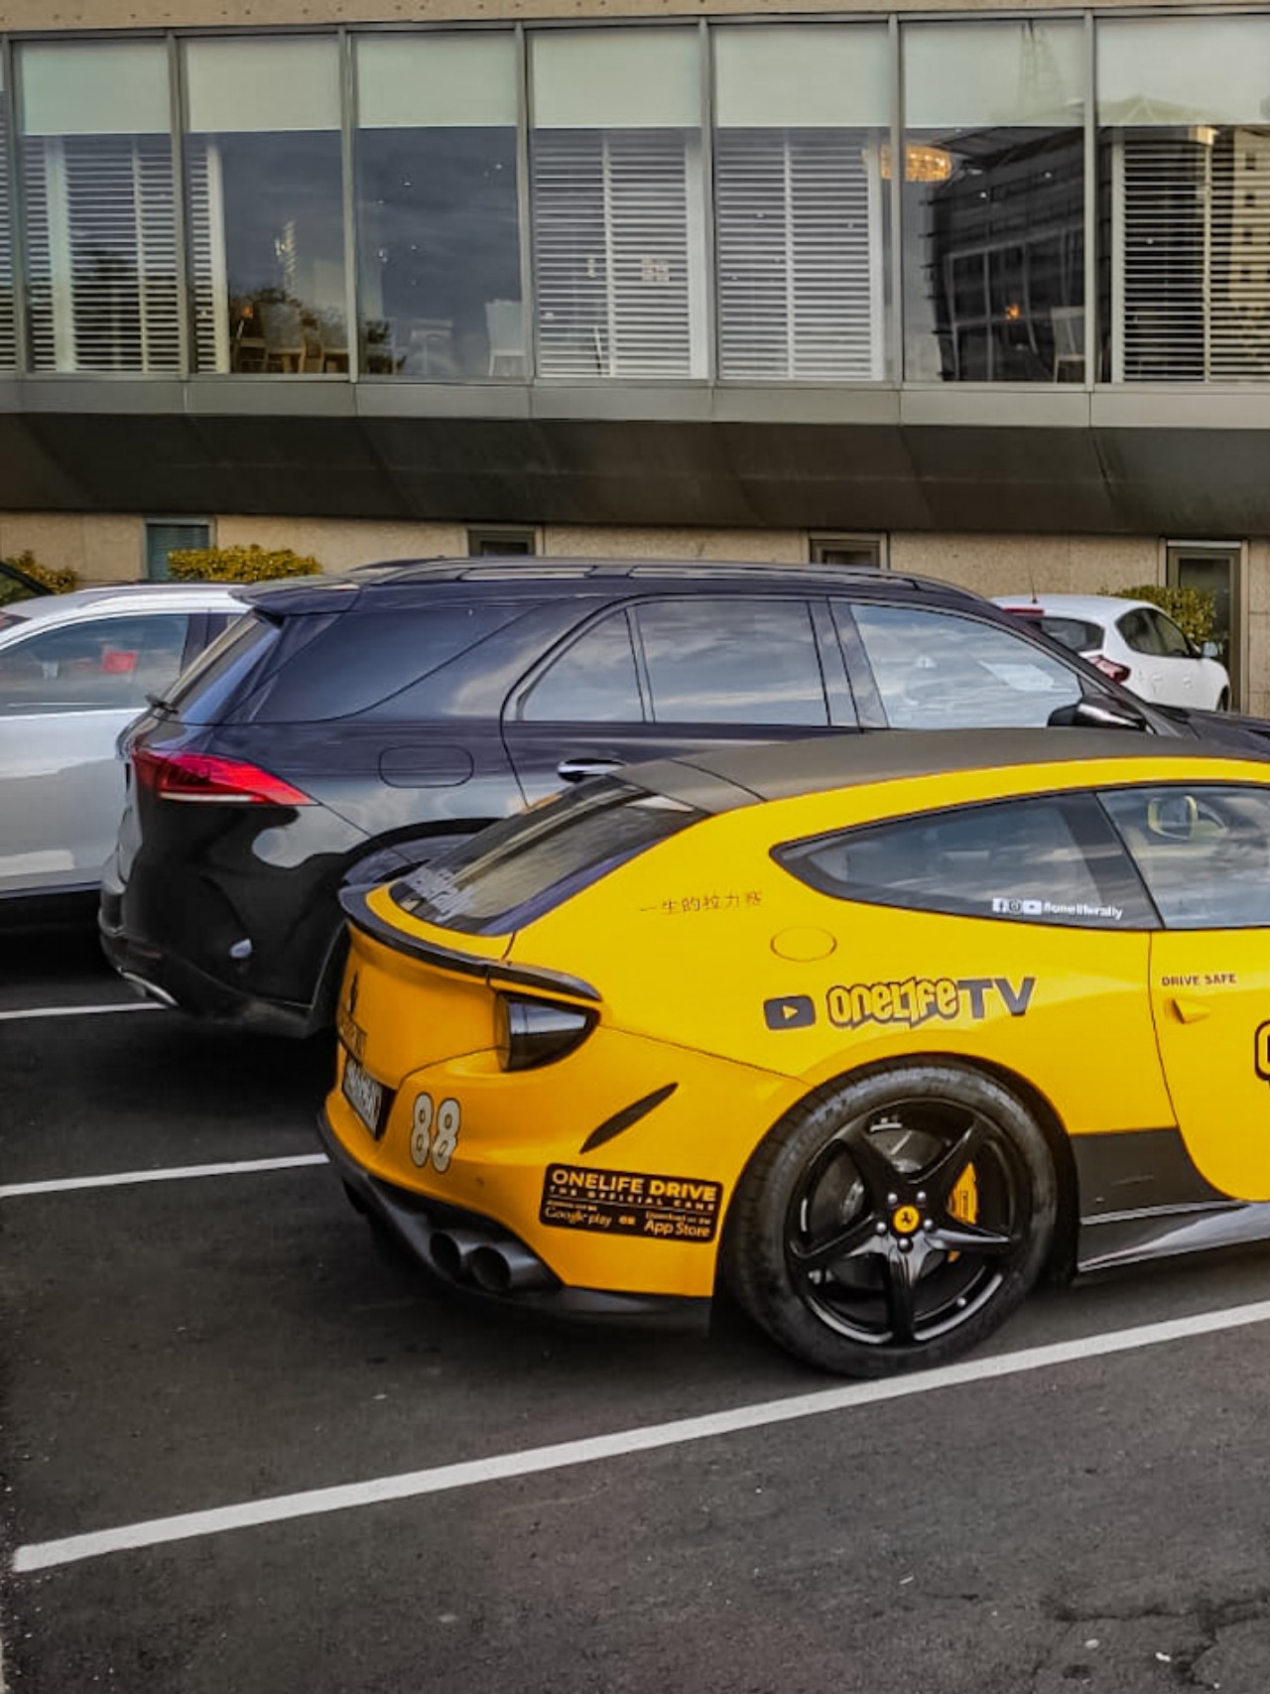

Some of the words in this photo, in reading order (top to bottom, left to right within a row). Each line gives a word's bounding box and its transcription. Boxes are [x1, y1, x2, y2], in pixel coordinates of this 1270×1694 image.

[1161, 975, 1198, 987] DRIVE
[1204, 973, 1237, 985] SAFE
[410, 1091, 462, 1174] 88
[551, 1169, 644, 1194] ONELIFE
[649, 1180, 717, 1202] DRIVE
[644, 1219, 674, 1236] App
[675, 1222, 711, 1238] Store
